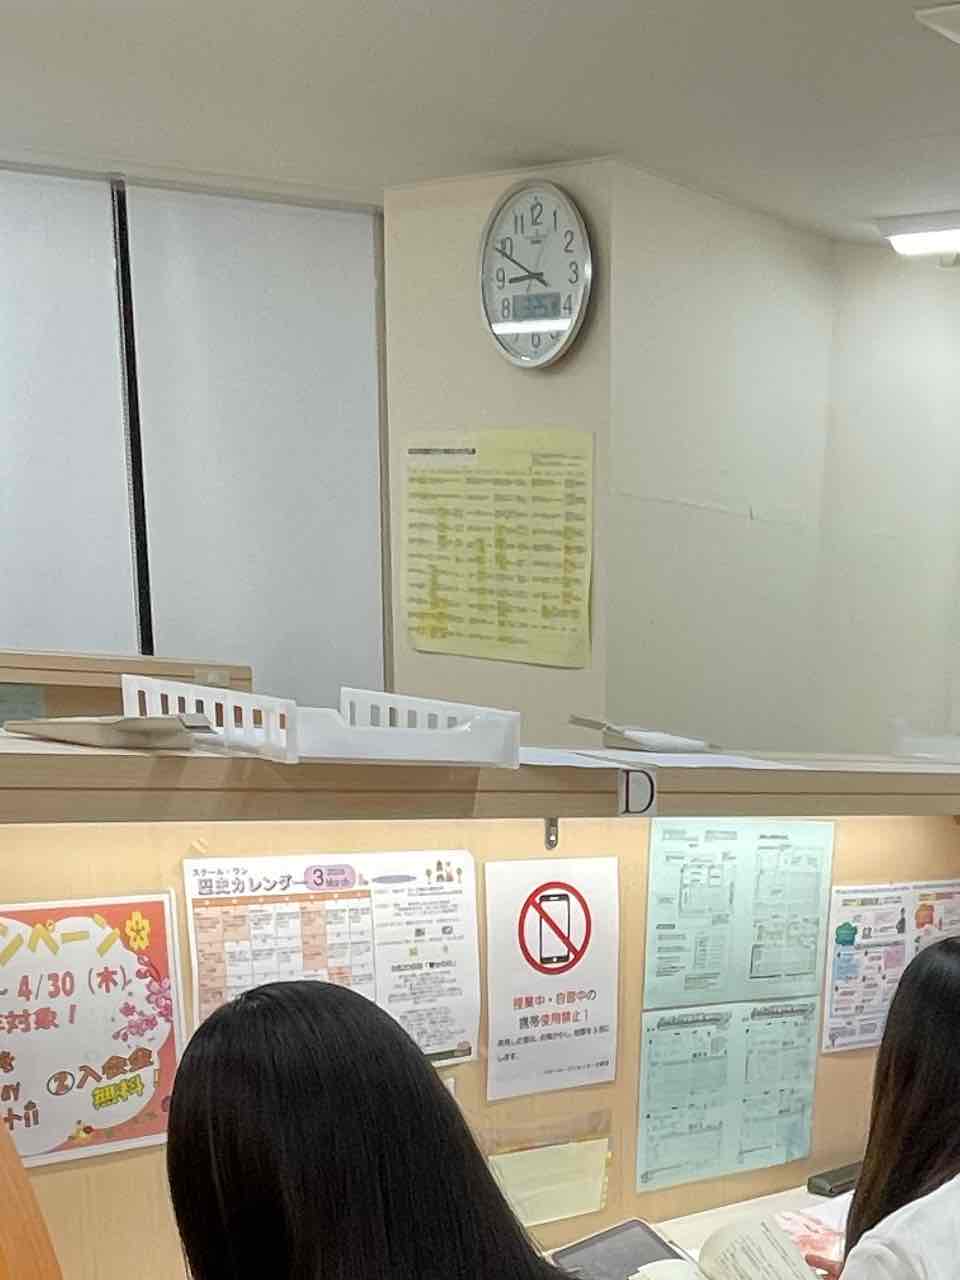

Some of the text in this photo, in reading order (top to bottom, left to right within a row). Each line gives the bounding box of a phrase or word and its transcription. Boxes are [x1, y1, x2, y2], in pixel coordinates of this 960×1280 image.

[513, 211, 525, 235] 11
[530, 202, 544, 227] 12
[552, 209, 558, 233] 1
[563, 230, 575, 254] 2
[496, 267, 506, 290] 9
[568, 261, 579, 285] 3
[501, 297, 511, 319] 8
[563, 294, 573, 316] 4
[622, 769, 655, 815] D
[313, 868, 324, 886] 3
